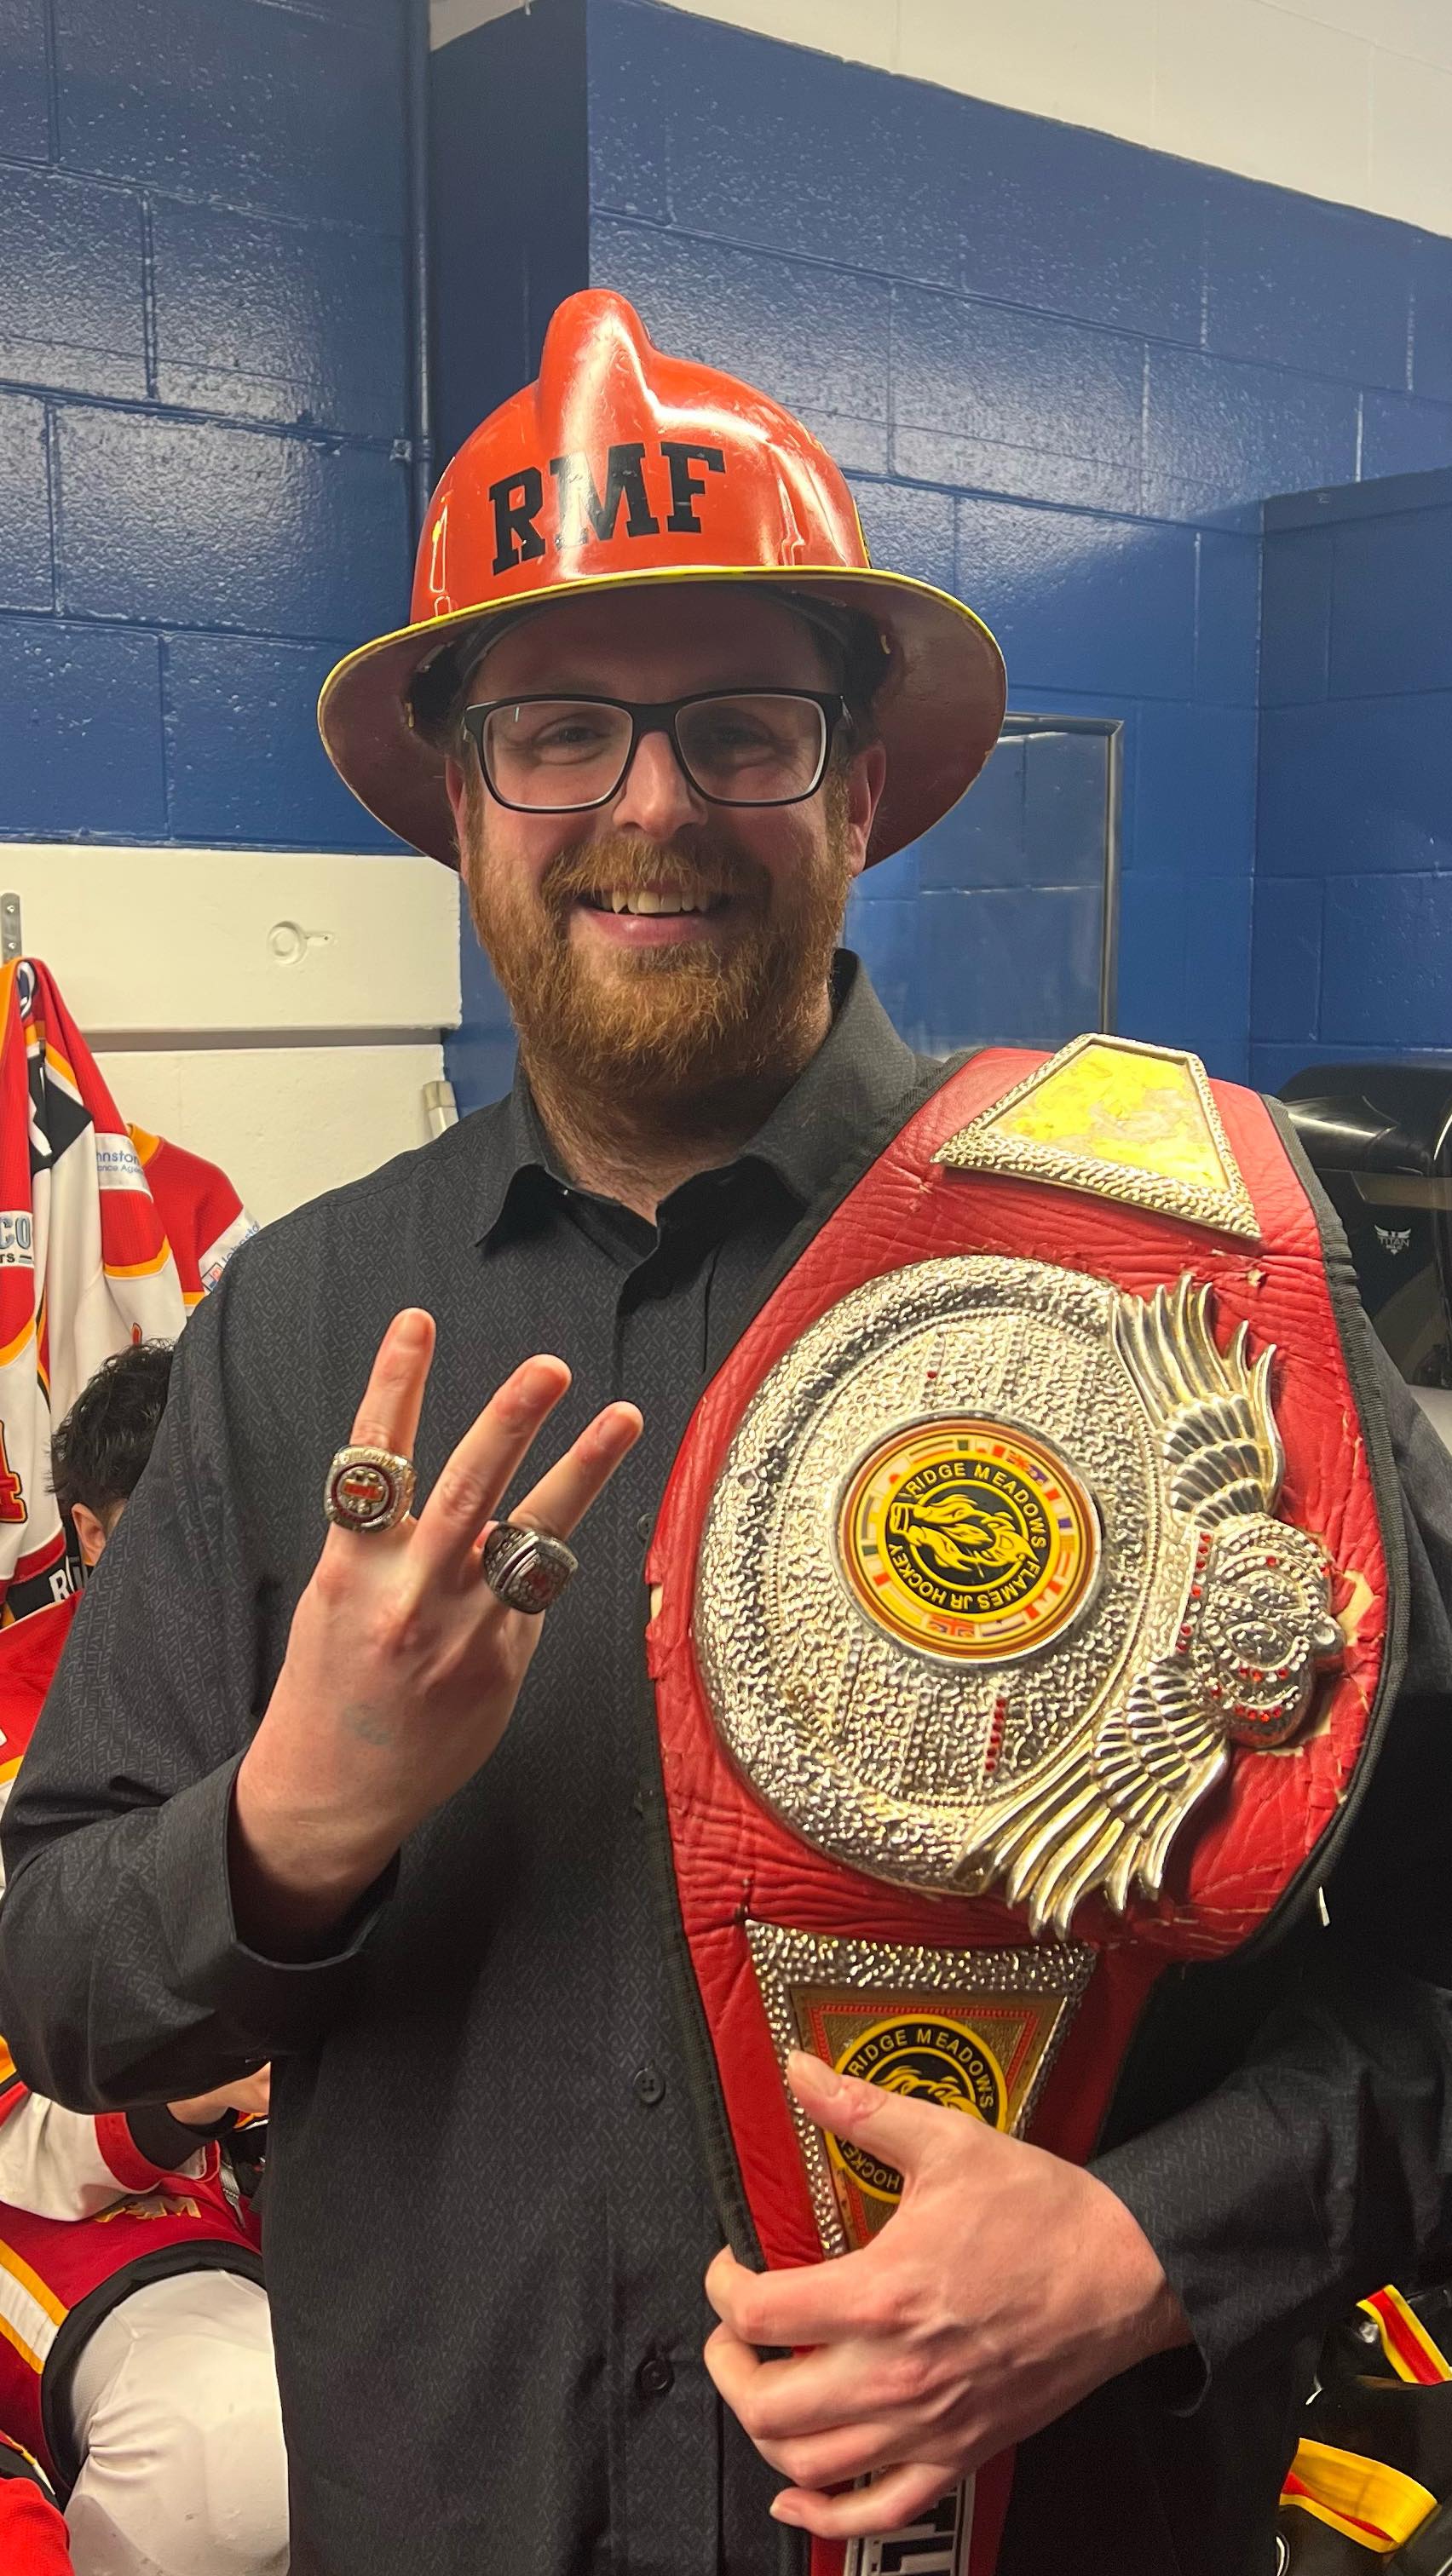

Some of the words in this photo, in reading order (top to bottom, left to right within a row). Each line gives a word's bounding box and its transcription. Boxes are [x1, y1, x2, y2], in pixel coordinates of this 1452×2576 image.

[489, 441, 726, 576] RMF
[1377, 1236, 1411, 1247] TITAN
[904, 1462, 966, 1497] RIDGE
[973, 1463, 1047, 1549] MEADOWS
[887, 1543, 945, 1606] HOCKEY
[950, 1592, 974, 1610] JR
[977, 1559, 1041, 1610] FLAMES
[848, 2029, 908, 2076] RIDGE
[916, 2028, 994, 2109] MEADOWS
